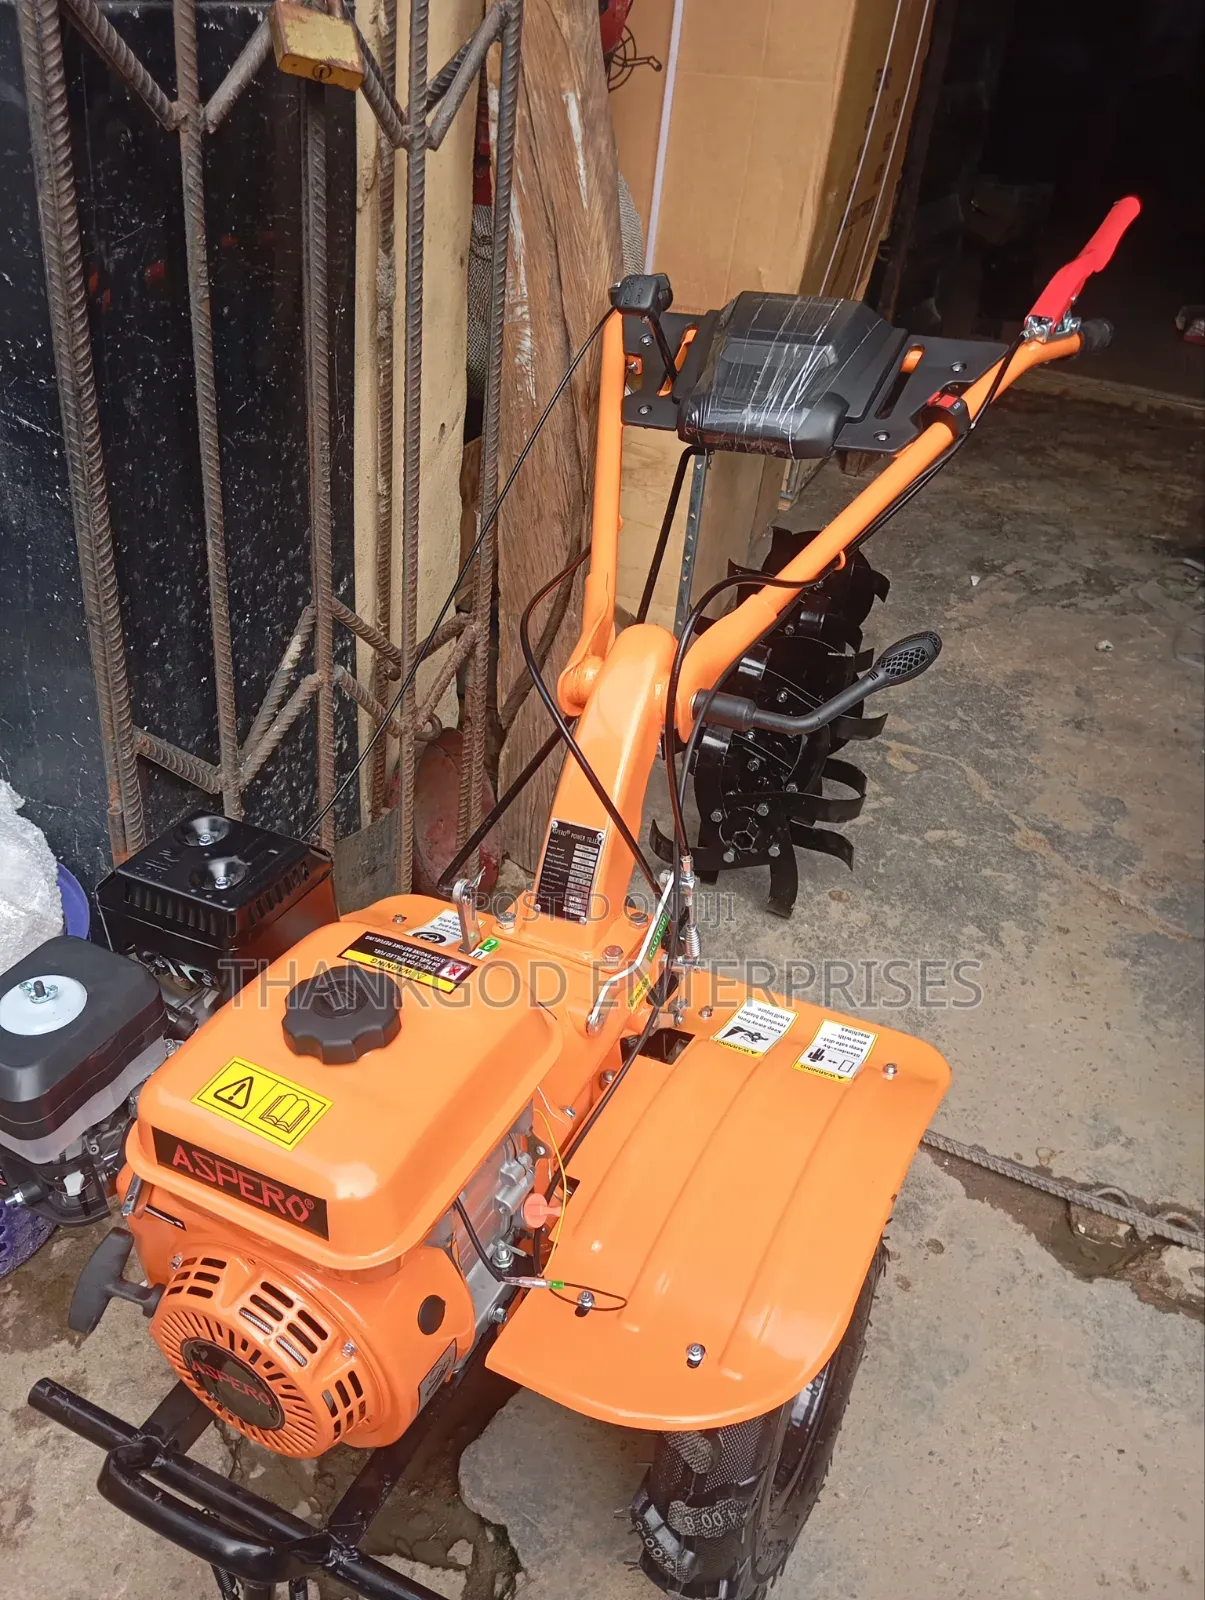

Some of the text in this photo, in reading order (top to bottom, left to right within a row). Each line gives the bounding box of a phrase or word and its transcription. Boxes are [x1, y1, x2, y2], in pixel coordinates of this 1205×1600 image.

[648, 917, 667, 958] CLUTCH
[364, 934, 445, 963] STOP ENGINE BEFORE REFUELING
[483, 939, 497, 950] 2
[372, 947, 388, 955] FUEL
[384, 952, 408, 962] SPILLED
[400, 951, 420, 959] LEAKS
[368, 957, 413, 975] WARNING
[415, 962, 437, 971] CHECK
[735, 1015, 782, 1033] Keep away from
[758, 1015, 787, 1027] revolving
[839, 1027, 870, 1039] machines
[716, 1039, 750, 1053] WARNING
[847, 1044, 864, 1052] keep
[799, 1064, 836, 1077] WARNING
[192, 1361, 272, 1406] ASPERO
